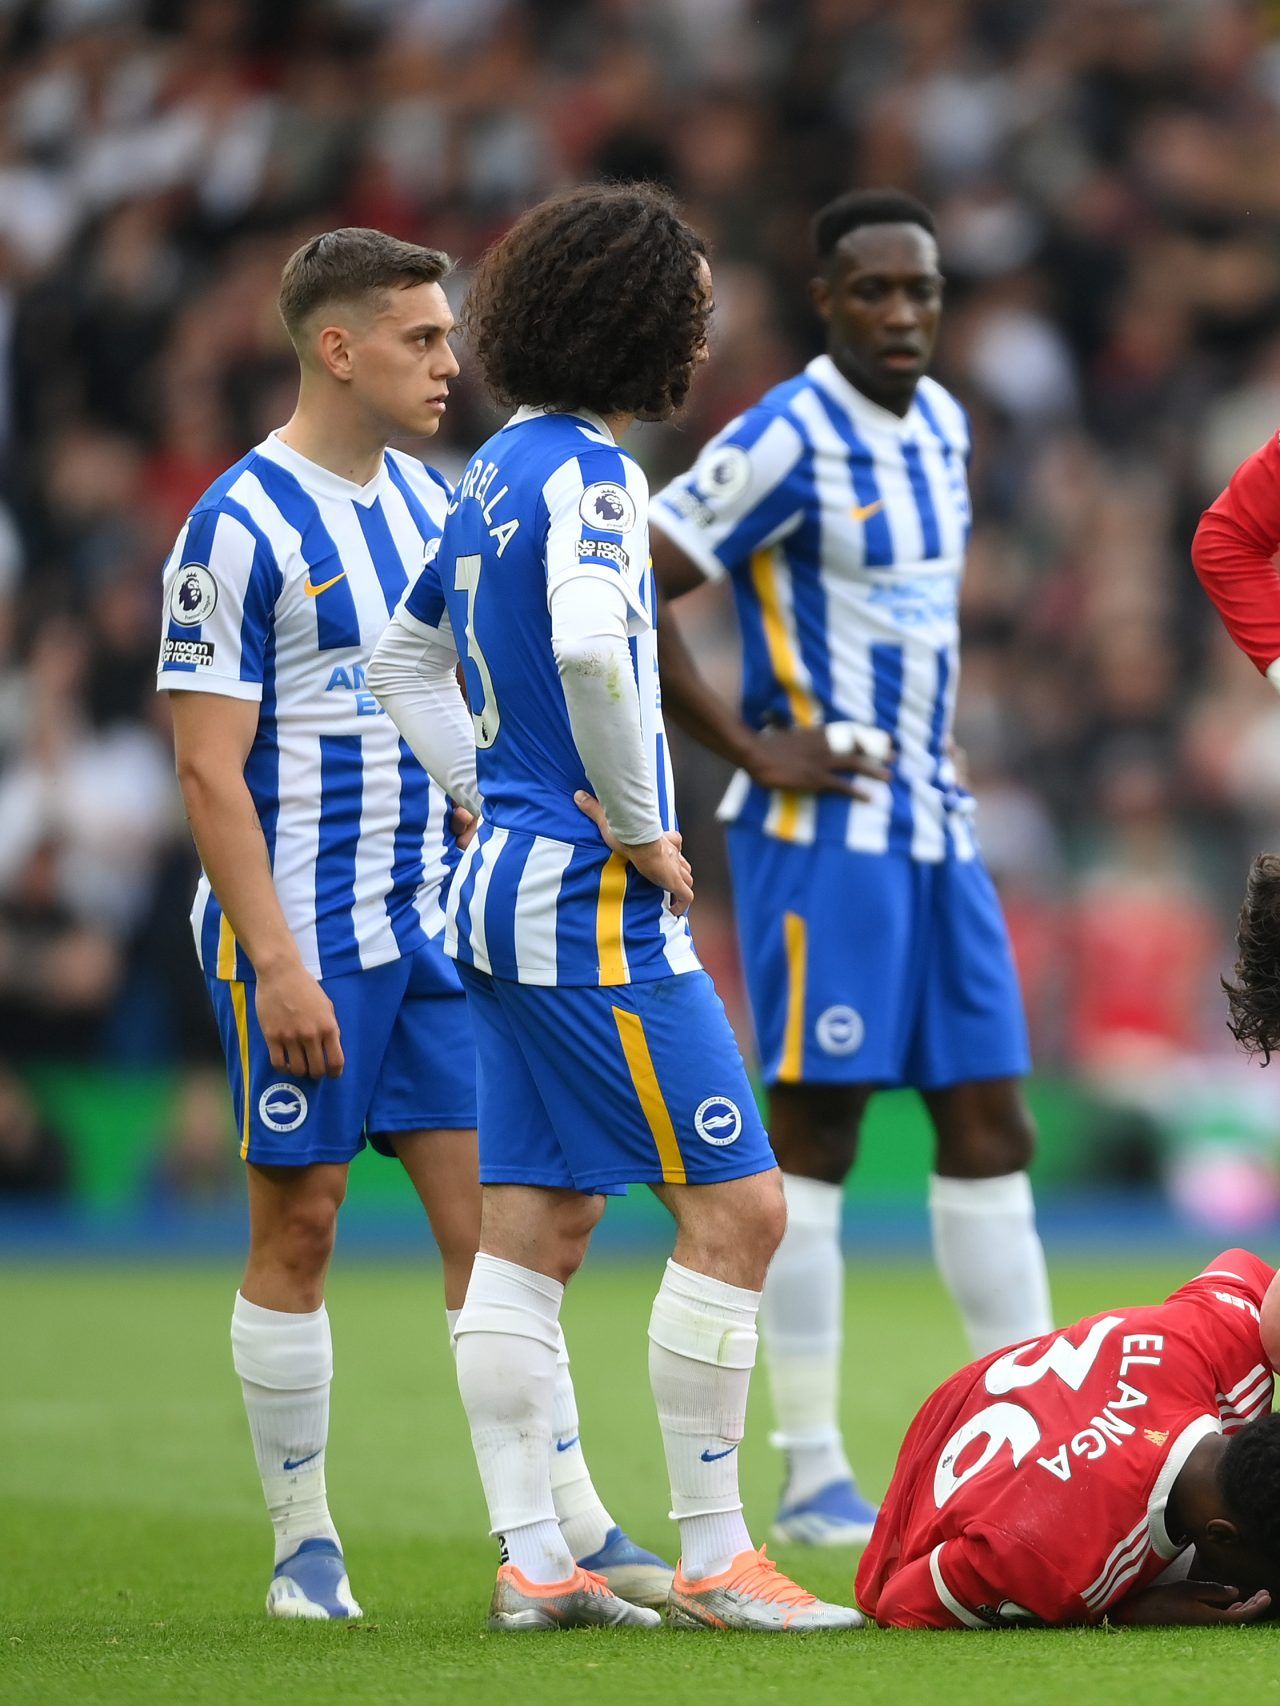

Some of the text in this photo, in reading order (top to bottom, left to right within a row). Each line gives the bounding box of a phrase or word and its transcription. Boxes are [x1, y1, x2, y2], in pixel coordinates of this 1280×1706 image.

[575, 540, 596, 549] No
[175, 641, 209, 655] room
[171, 651, 213, 667] racism
[933, 1315, 1127, 1509] 36
[1036, 1333, 1165, 1482] ELANGA
